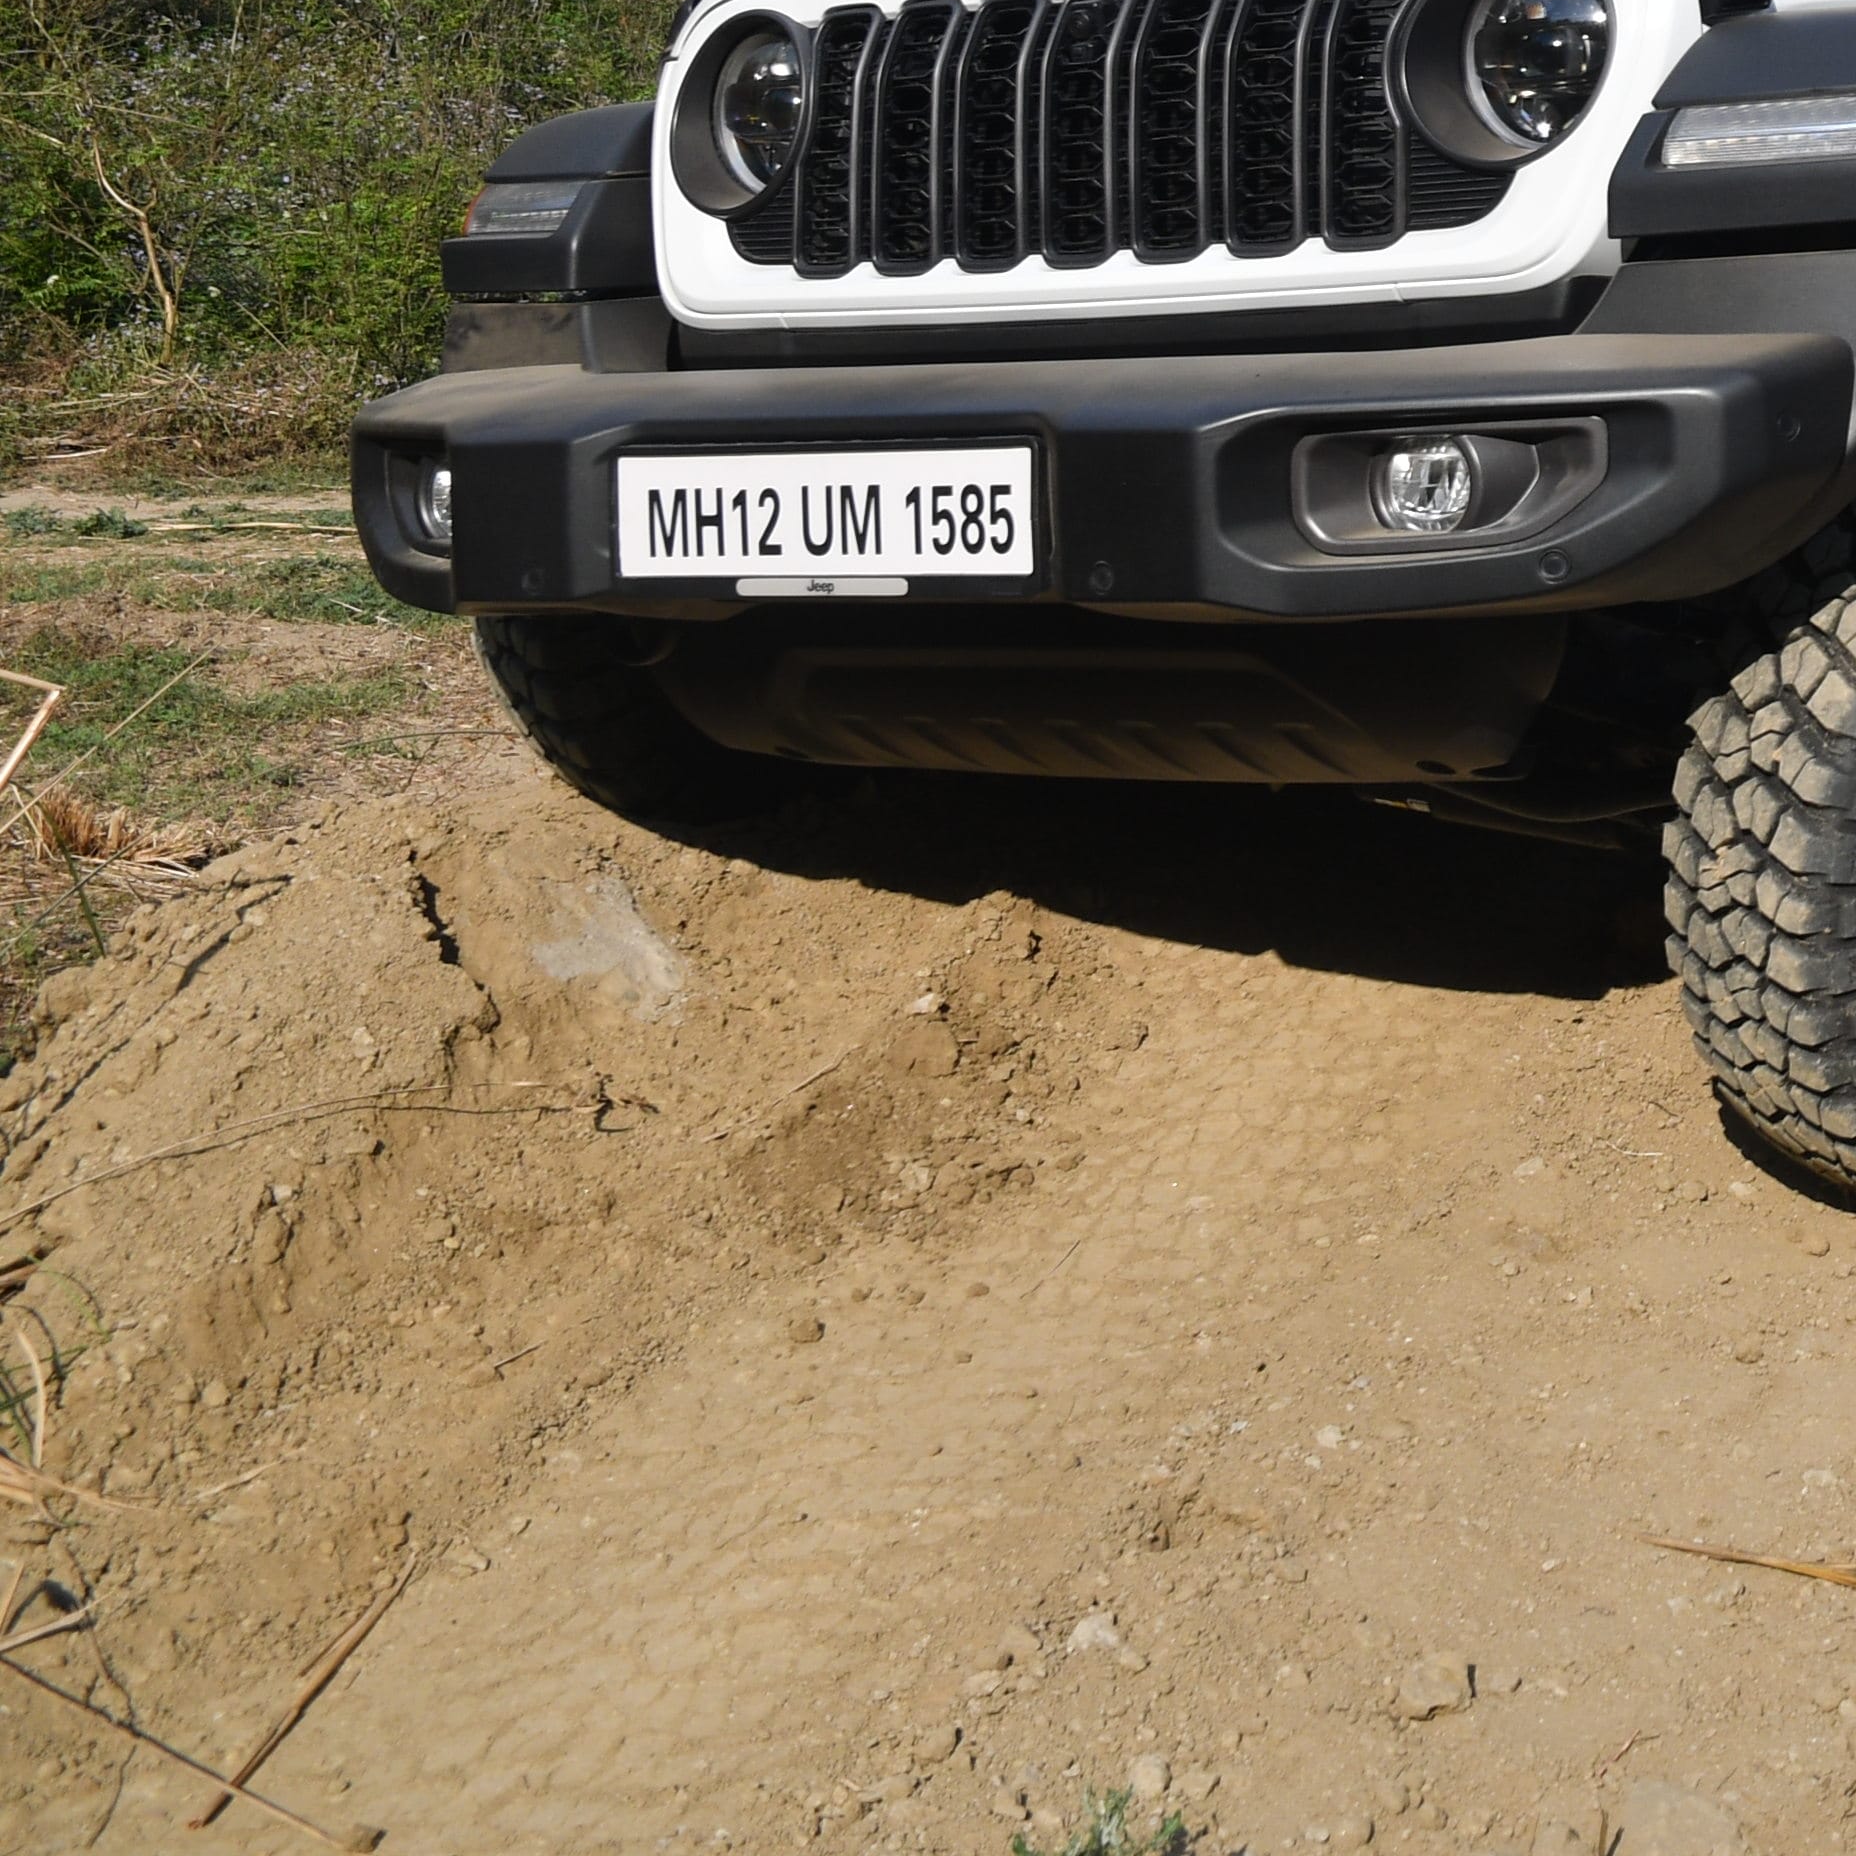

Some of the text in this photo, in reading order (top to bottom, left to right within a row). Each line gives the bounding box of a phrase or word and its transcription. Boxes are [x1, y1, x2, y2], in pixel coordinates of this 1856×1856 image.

[648, 484, 1014, 558] MH12 UM 1585
[806, 579, 835, 595] Jeep
